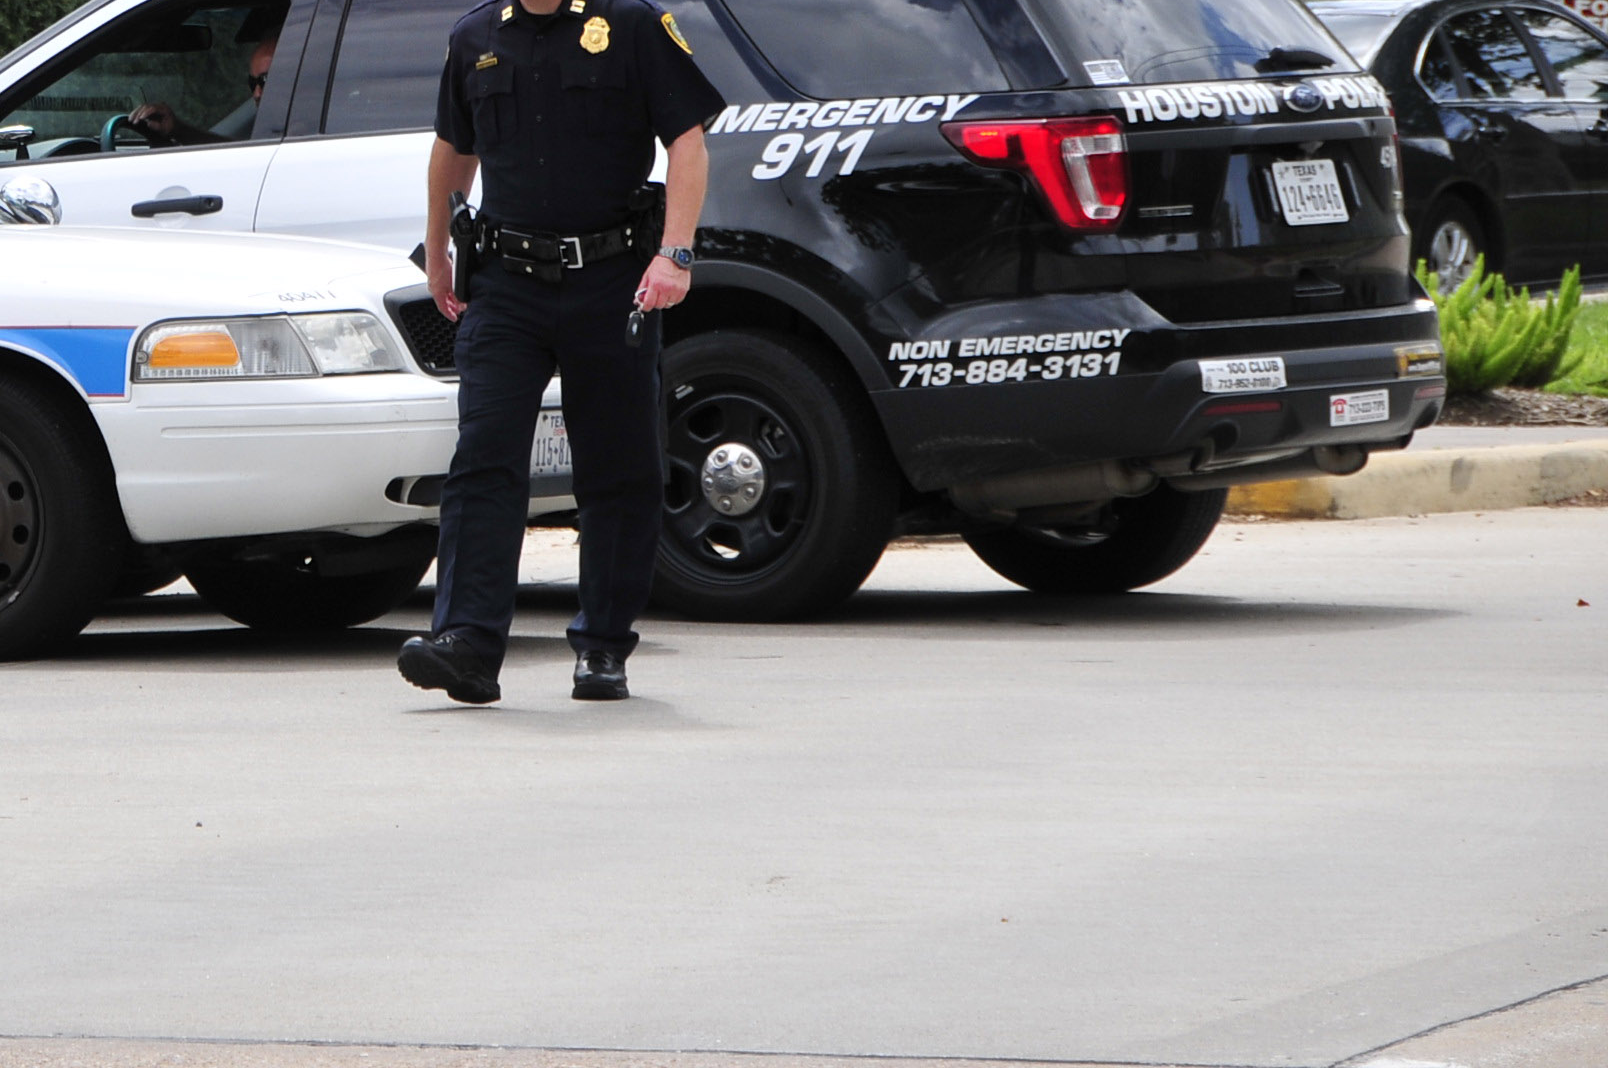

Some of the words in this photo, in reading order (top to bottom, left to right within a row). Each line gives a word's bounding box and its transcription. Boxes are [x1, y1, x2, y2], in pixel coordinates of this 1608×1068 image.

[709, 94, 982, 134] MERGENCY
[1117, 83, 1279, 124] HOUSTON
[752, 129, 874, 180] 911
[1292, 164, 1317, 176] TEXAS
[888, 340, 950, 361] NON
[958, 328, 1131, 357] EMERGENCY
[898, 352, 1121, 388] 713-884-3131
[1227, 362, 1247, 374] 100
[1249, 360, 1280, 373] CLUB
[551, 415, 565, 428] TEX
